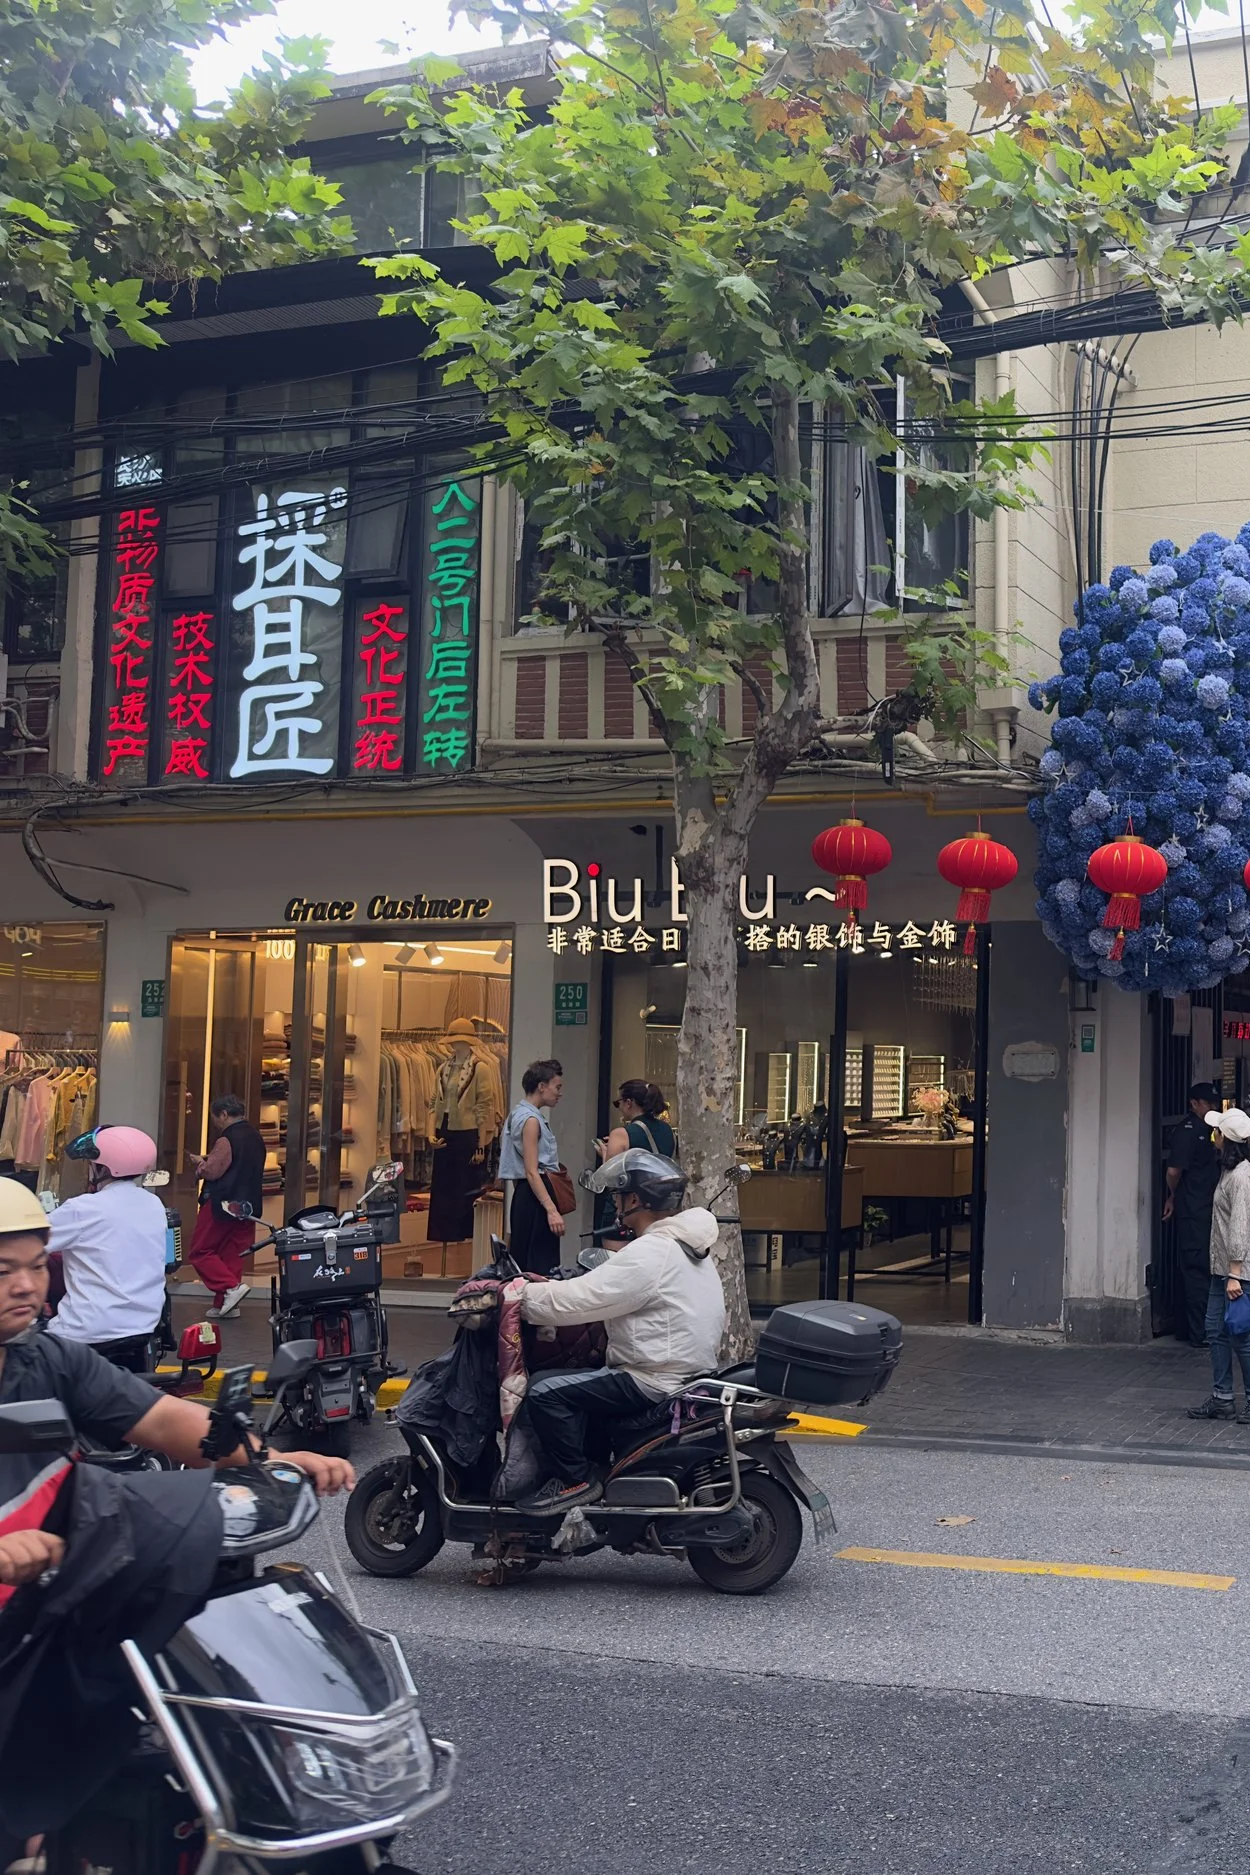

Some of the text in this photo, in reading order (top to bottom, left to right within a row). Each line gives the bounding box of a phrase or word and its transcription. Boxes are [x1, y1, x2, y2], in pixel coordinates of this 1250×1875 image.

[103, 505, 161, 777] 非物质文化遗产
[164, 611, 215, 779] 技术权威
[354, 603, 407, 772] 文化正统
[283, 893, 492, 924] Grace Cashmere
[542, 857, 643, 924] Biu
[547, 919, 957, 955] 非常适合日搭的银饰与金饰
[559, 985, 583, 1000] 250
